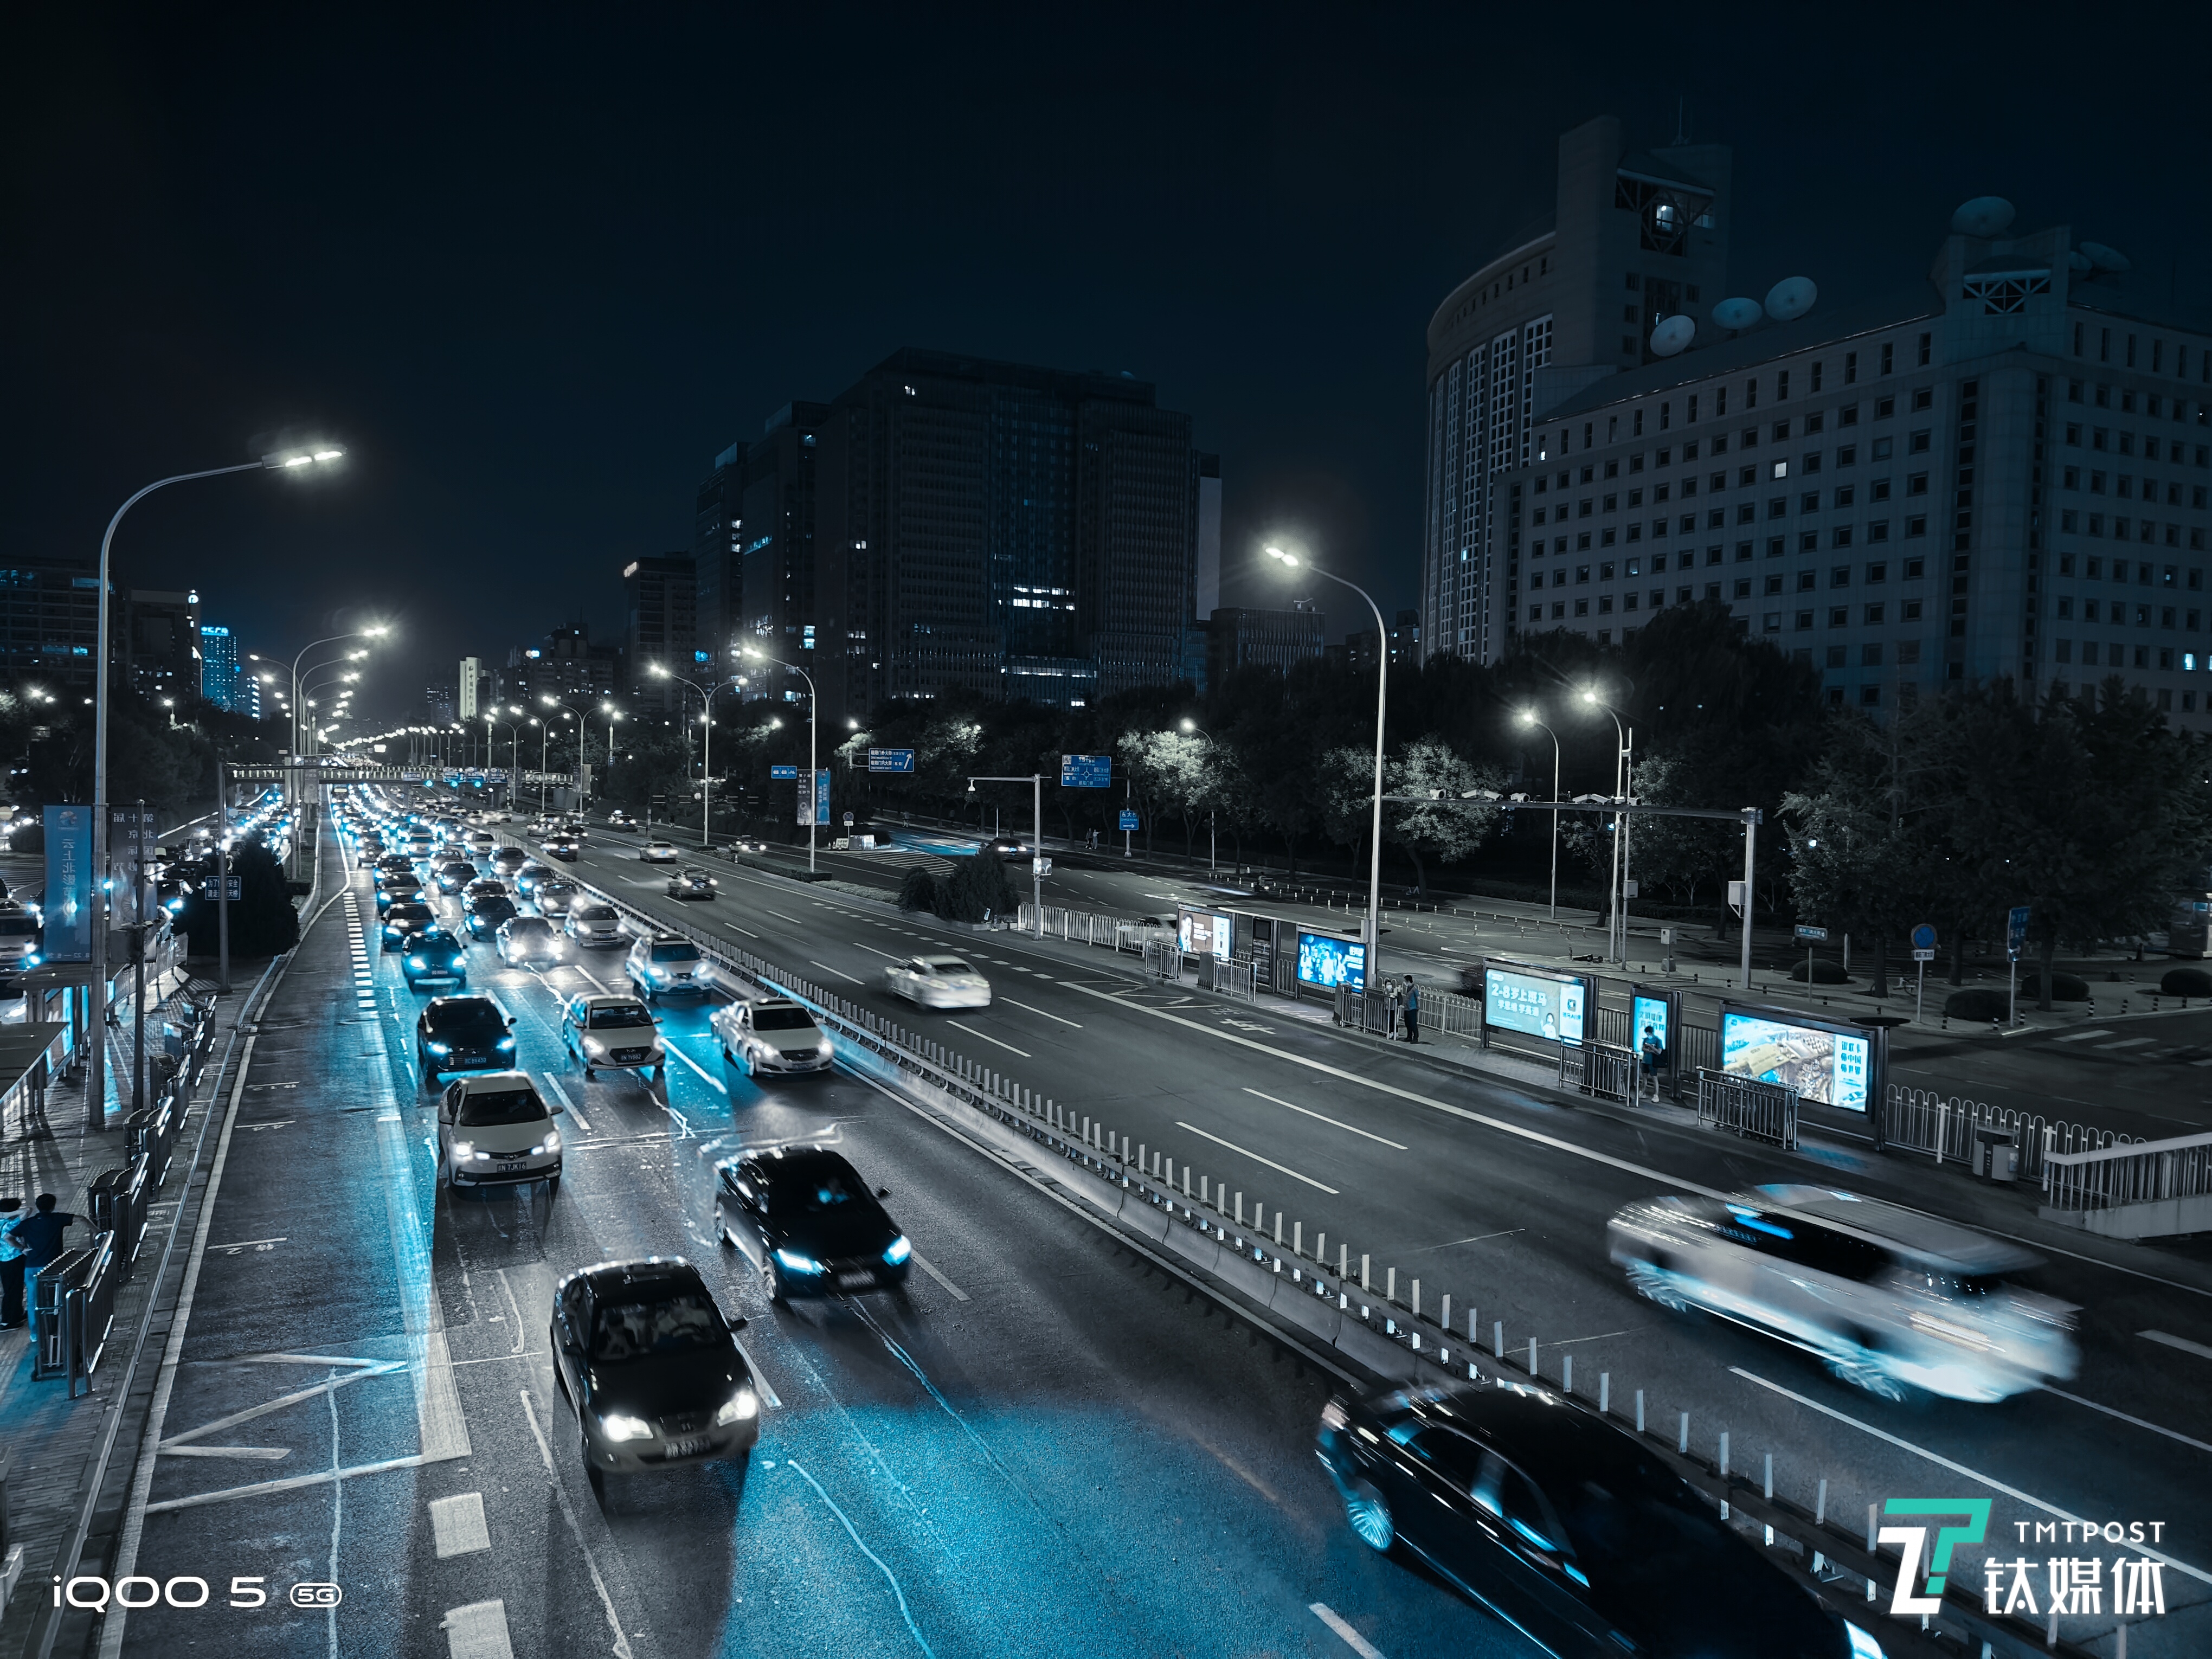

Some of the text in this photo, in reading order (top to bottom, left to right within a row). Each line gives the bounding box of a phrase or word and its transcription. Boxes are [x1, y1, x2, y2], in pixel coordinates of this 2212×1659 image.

[208, 879, 238, 888] 为了安全
[1491, 983, 1547, 1006] 2-8岁上斑马
